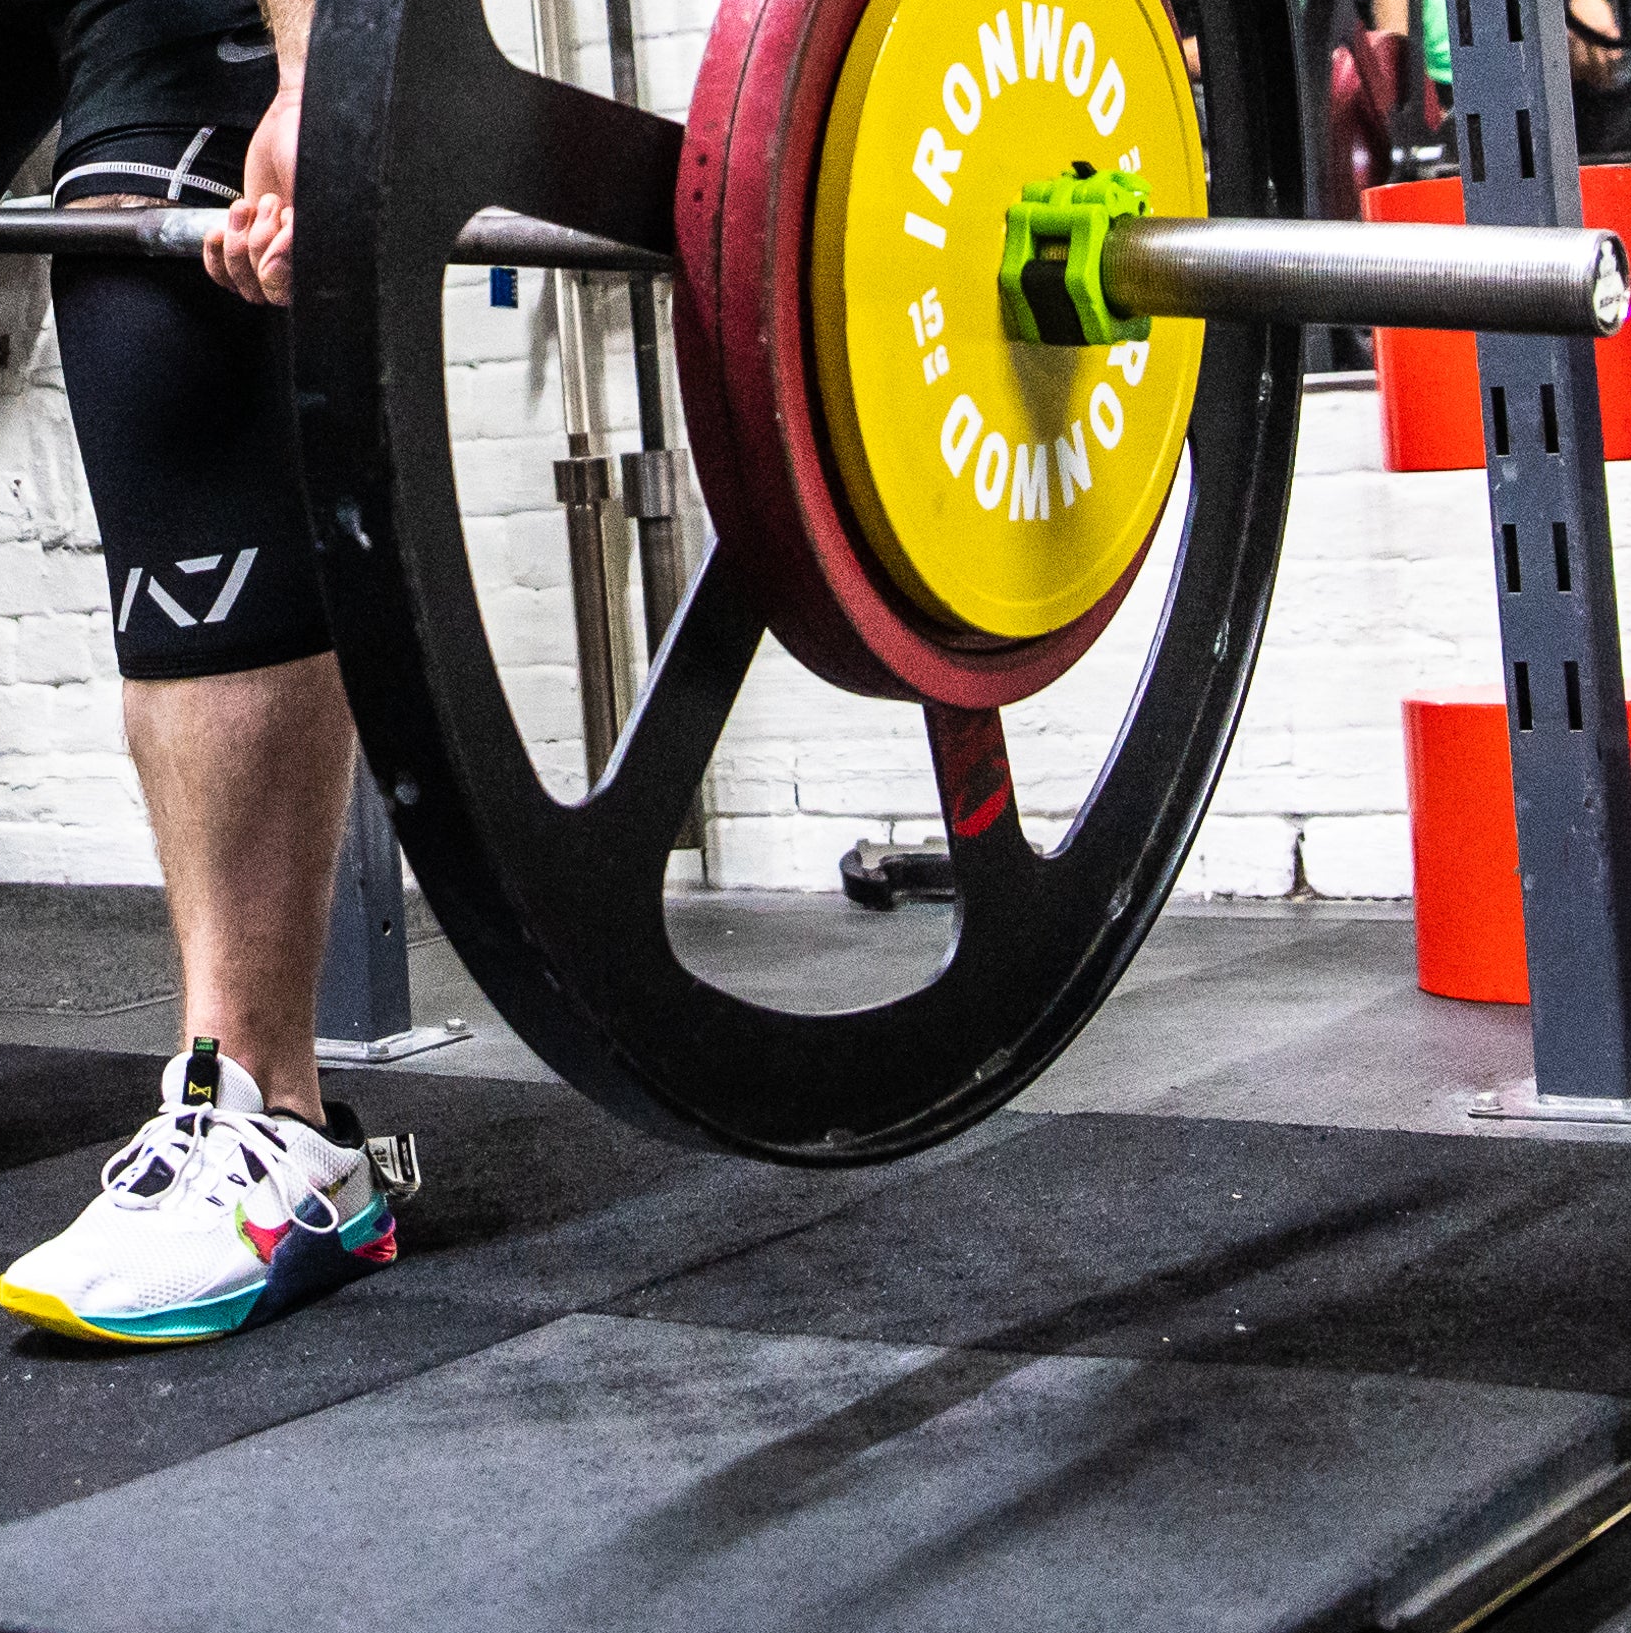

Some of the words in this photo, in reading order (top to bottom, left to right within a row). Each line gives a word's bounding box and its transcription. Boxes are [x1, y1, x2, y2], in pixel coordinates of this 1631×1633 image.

[903, 1, 1126, 250] IRONWOD
[907, 286, 945, 348] 15
[940, 340, 1150, 522] RONWOD
